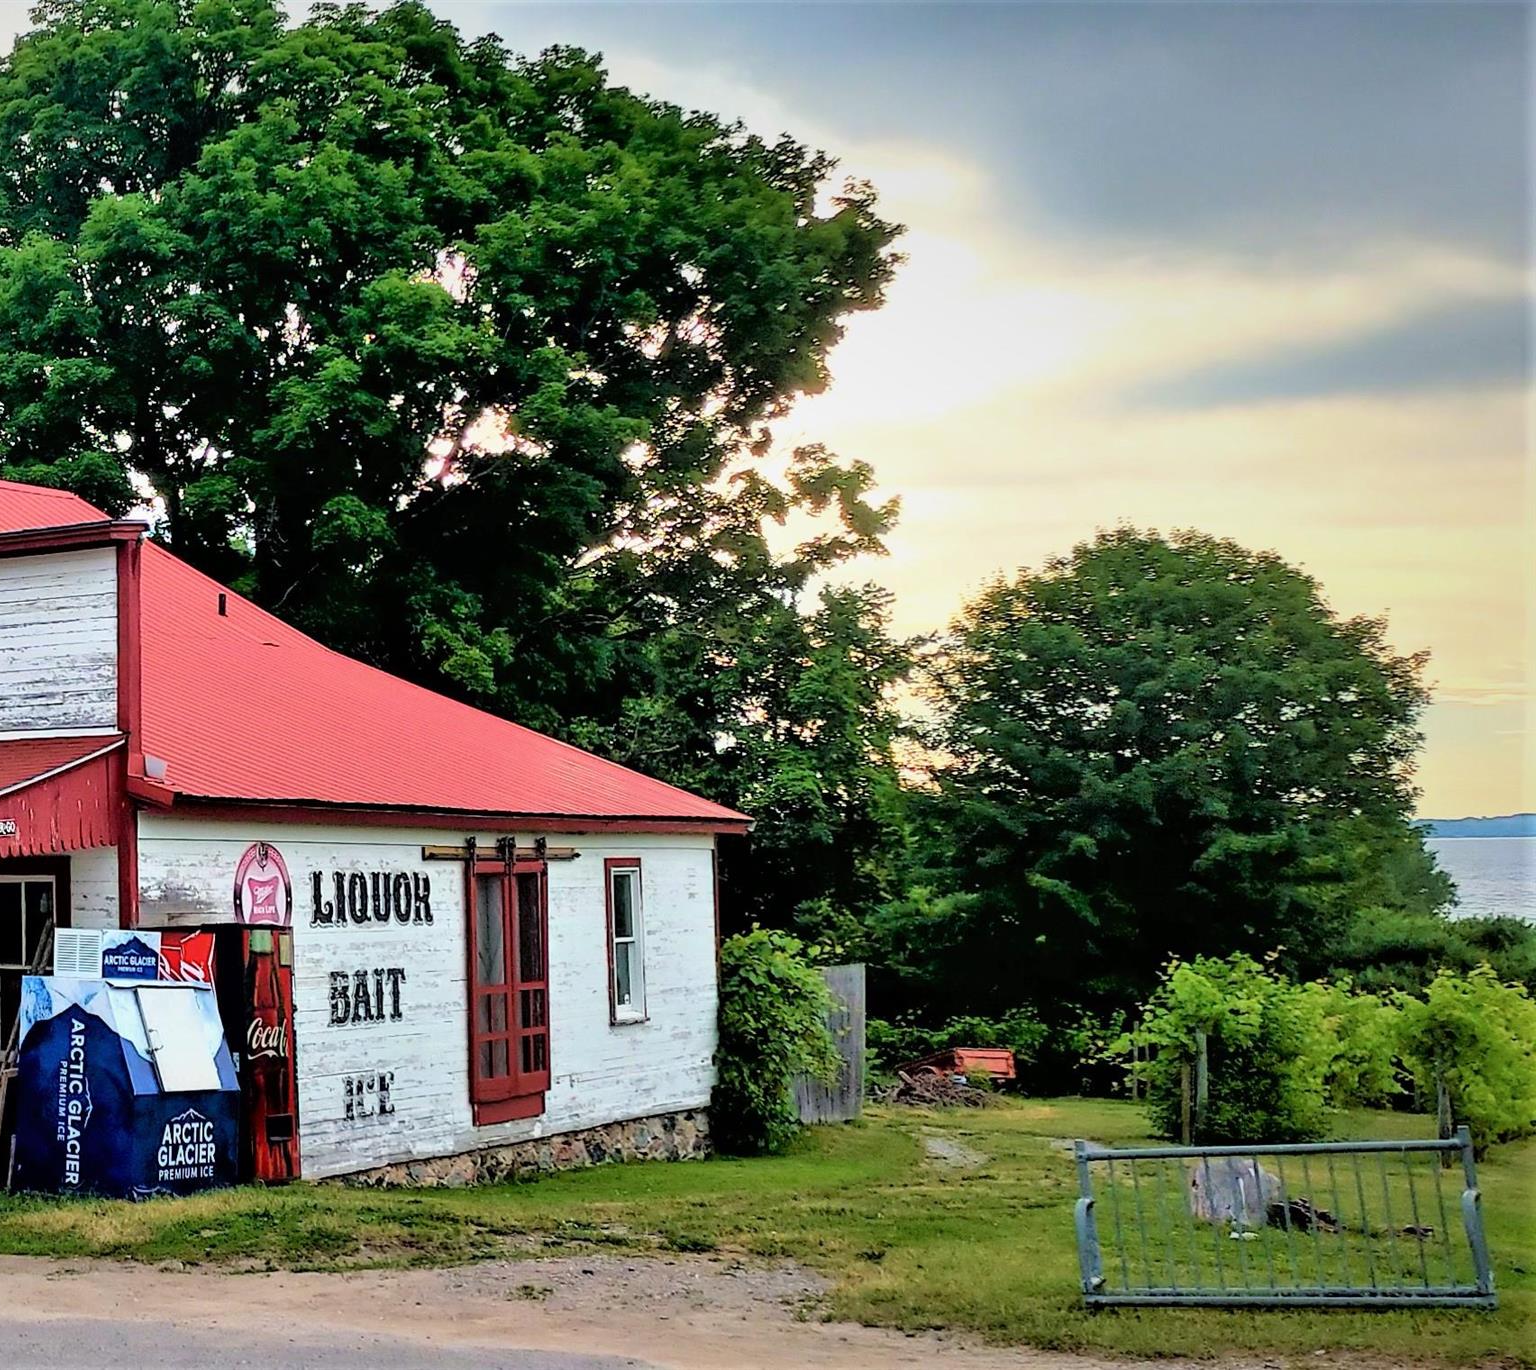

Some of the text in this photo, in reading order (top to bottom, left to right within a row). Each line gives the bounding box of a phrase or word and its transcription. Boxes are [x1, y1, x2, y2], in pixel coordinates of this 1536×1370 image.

[310, 870, 433, 928] LIQUOR
[104, 955, 157, 967] ARCTIC GLACIER
[328, 968, 406, 1027] BAIT
[57, 1060, 68, 1141] PREMIUM ICE
[65, 1018, 85, 1185] ARCTIC GLACIER
[343, 1071, 395, 1121] ICE
[158, 1143, 216, 1167] GLACIER
[162, 1121, 214, 1145] ARCTIC
[159, 1165, 214, 1181] PREMIUM ICE
